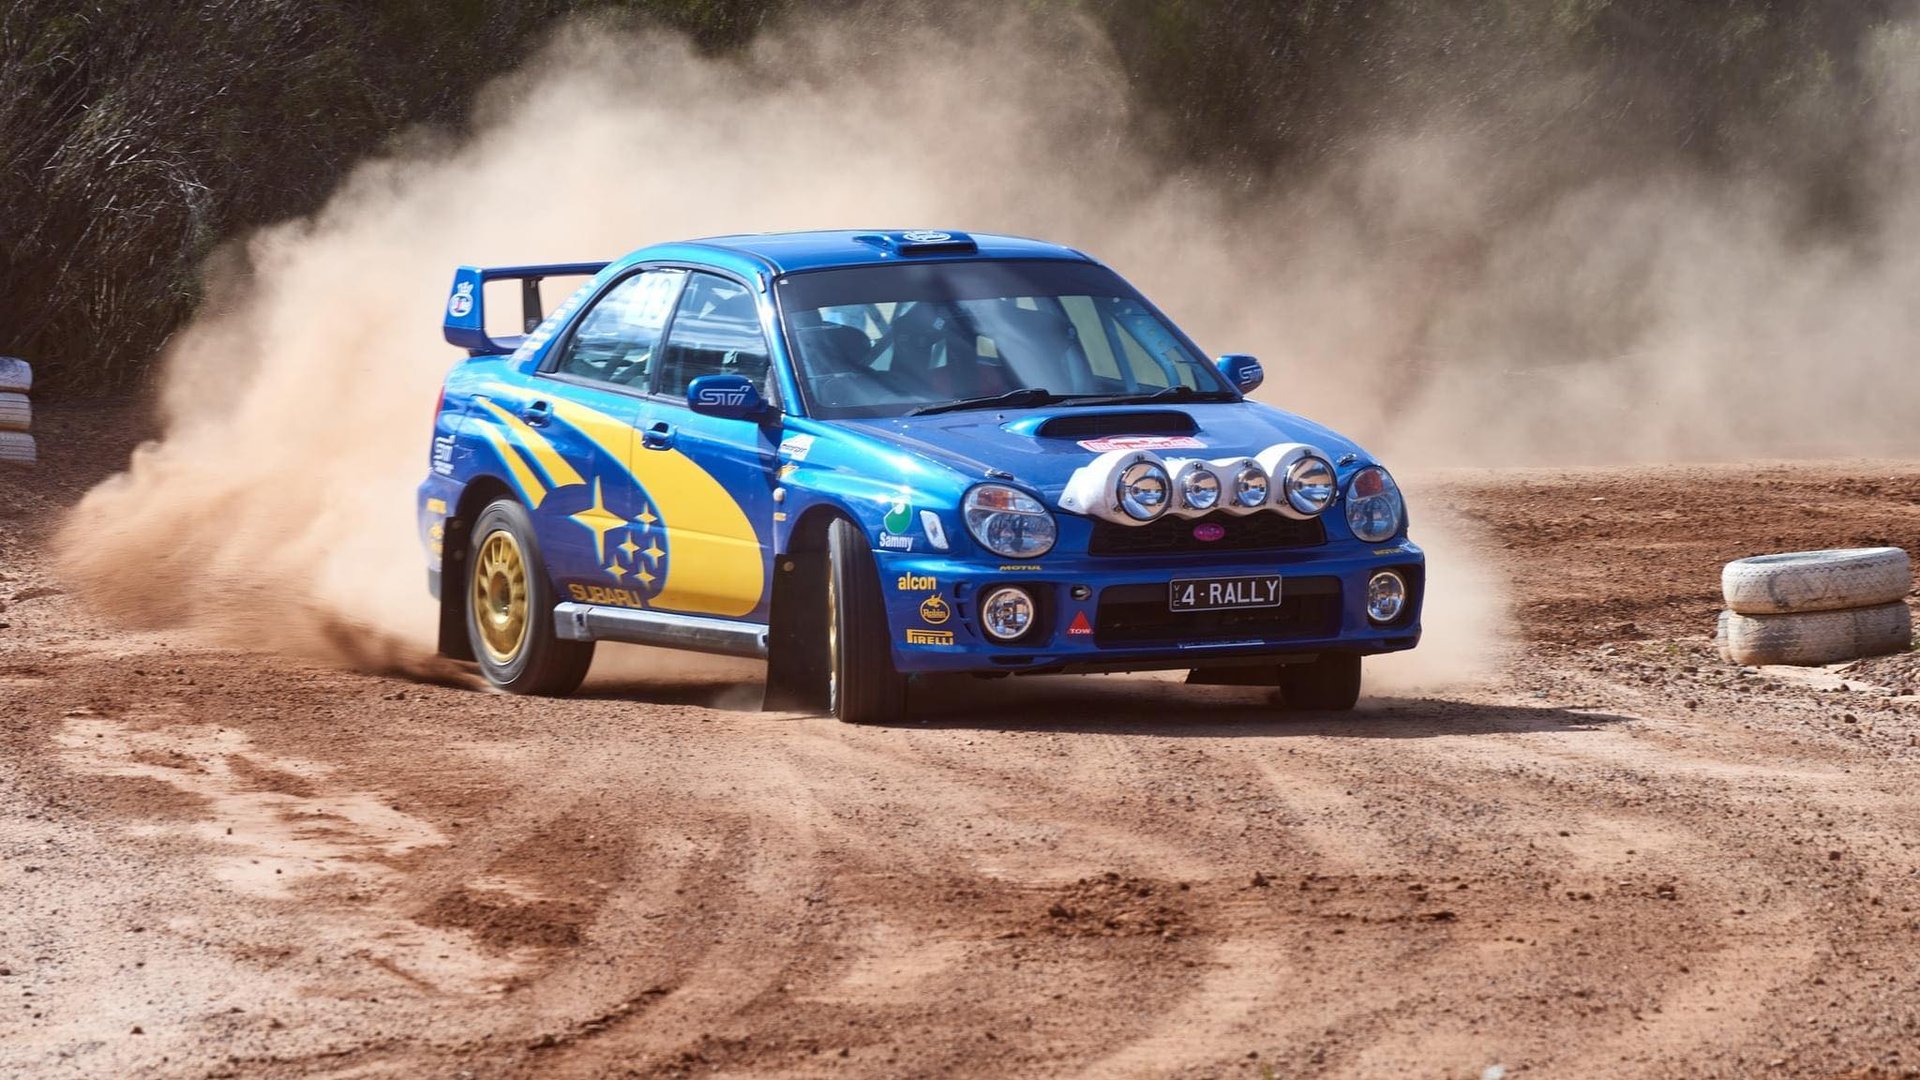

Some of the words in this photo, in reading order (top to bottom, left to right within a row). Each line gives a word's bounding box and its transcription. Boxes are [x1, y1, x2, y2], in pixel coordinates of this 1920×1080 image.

[879, 531, 913, 552] Sammy
[898, 571, 936, 590] alcon
[567, 583, 643, 608] SUBARU
[906, 629, 954, 646] PIRELLI
